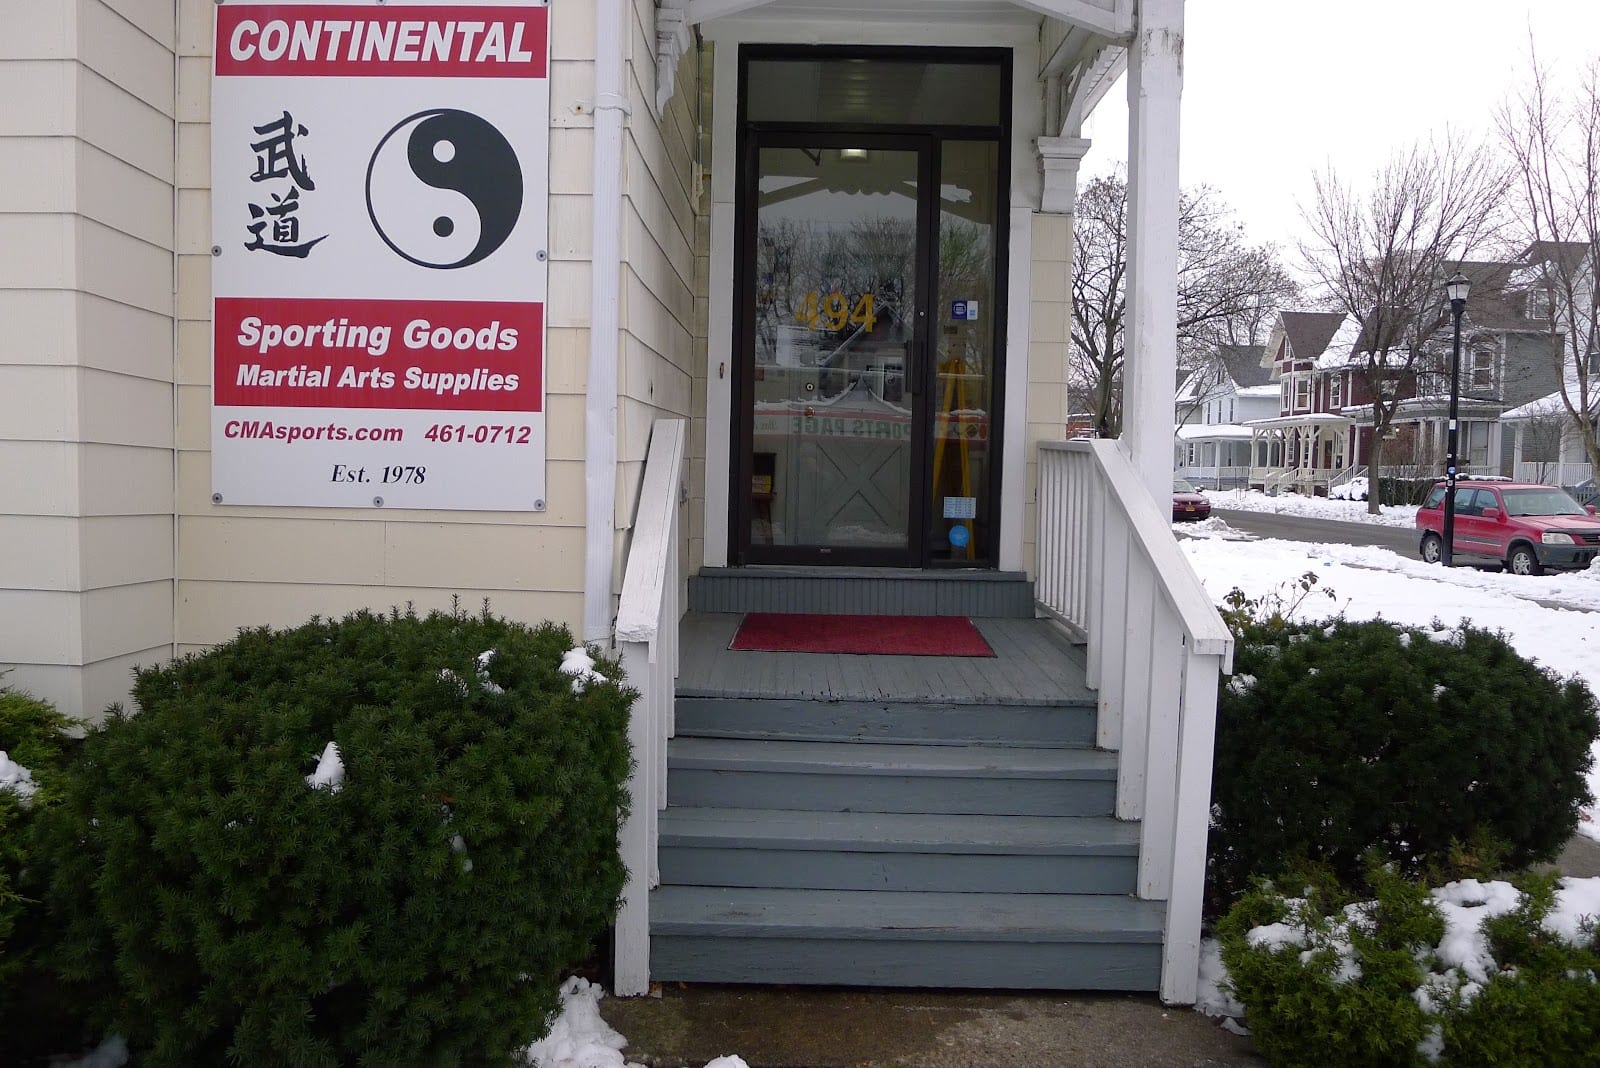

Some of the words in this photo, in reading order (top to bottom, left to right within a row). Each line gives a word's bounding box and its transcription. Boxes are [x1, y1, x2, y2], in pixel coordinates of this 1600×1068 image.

[229, 19, 533, 63] CONTINENTAL
[244, 110, 330, 259] 武道
[794, 292, 877, 333] 494
[237, 316, 392, 356] Sporting
[403, 319, 518, 351] Goods
[236, 364, 331, 388] Martial
[337, 366, 396, 390] Arts
[403, 367, 520, 395] Supplies
[224, 420, 403, 443] CMAsports.com
[425, 425, 531, 444] 461-0712
[331, 464, 370, 483] Est.
[380, 465, 426, 484] 1978
